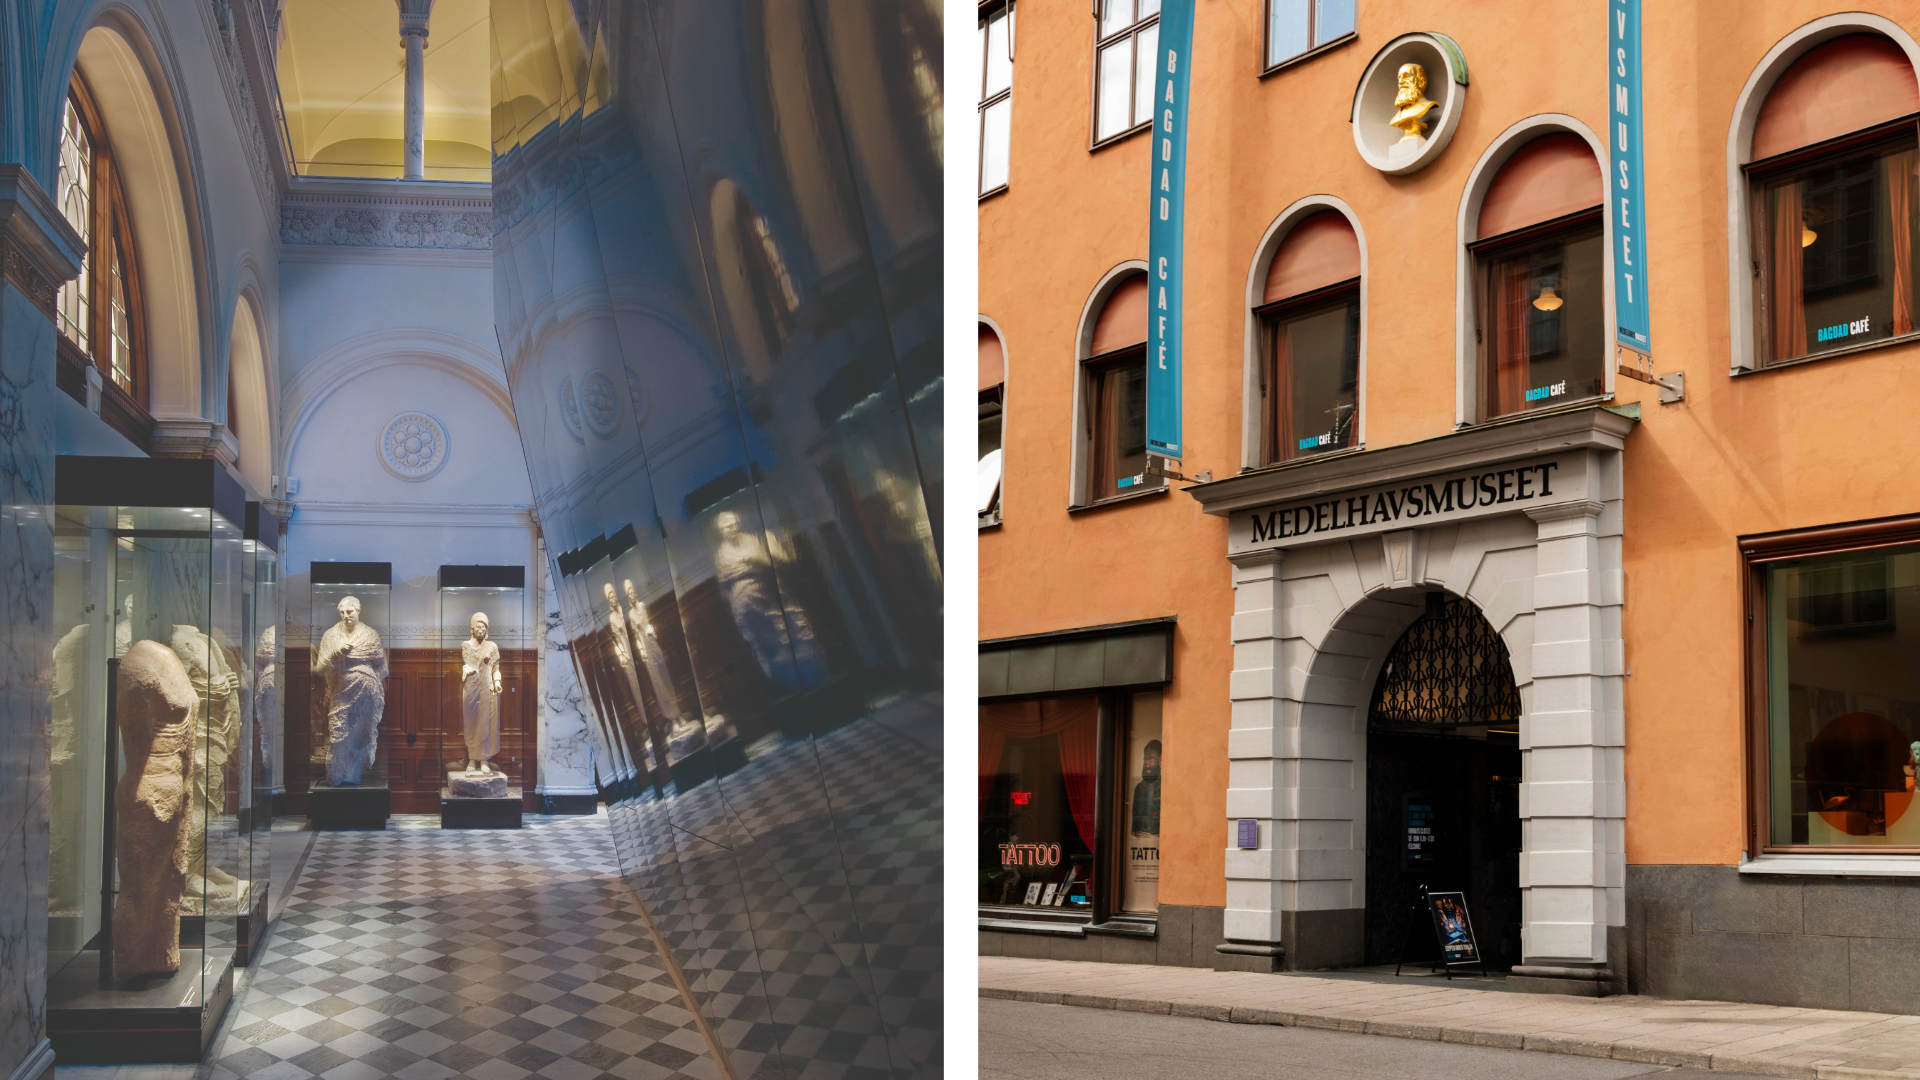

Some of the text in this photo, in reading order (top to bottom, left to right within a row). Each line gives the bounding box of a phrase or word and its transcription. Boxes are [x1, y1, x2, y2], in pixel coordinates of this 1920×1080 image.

[1616, 0, 1634, 304] VSMUSEET
[1158, 49, 1177, 370] BAGDAD CAFÉ
[1818, 315, 1870, 342] BAGDAD CAFÉ
[1525, 379, 1566, 402] BAGDAD CAFÉ
[1318, 430, 1331, 446] CAFÉ
[1251, 461, 1558, 543] MEDELHAVSMUSEET
[1393, 544, 1405, 574] 2
[998, 843, 1061, 867] TATTOO
